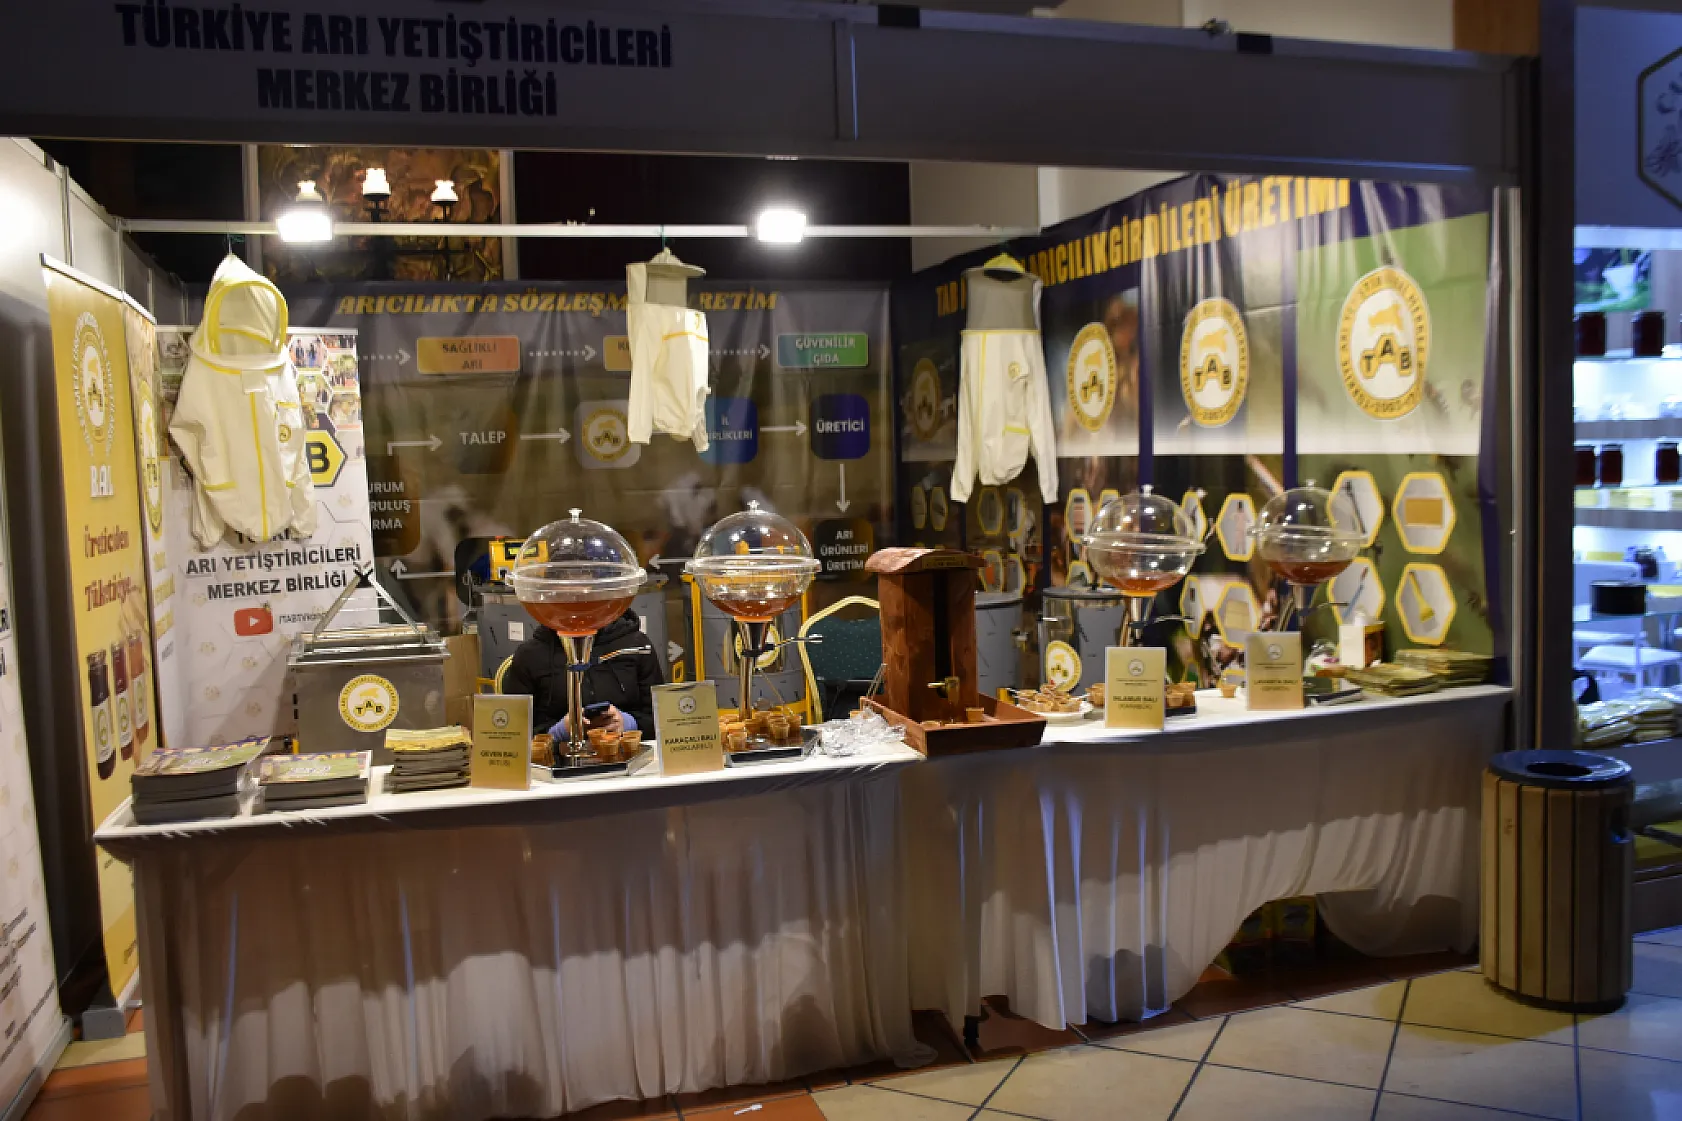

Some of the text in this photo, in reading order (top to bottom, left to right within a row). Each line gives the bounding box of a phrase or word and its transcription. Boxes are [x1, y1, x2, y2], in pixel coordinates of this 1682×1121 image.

[115, 0, 673, 68] TÜRKİYE ARI YETİŞTİRİCİLERİ
[257, 67, 557, 116] MERKEZ BİRLİĞİ
[335, 294, 498, 315] ARICILIKTA
[795, 336, 856, 350] GÜVENİLİR
[1363, 339, 1410, 372] TAB
[1195, 359, 1230, 387] TAB
[816, 416, 865, 433] ÜRETİCİ
[459, 430, 507, 446] TALEP
[835, 529, 854, 540] ARI
[186, 558, 217, 574] ARI
[221, 543, 361, 572] YETİŞTİRİCİLERİ
[820, 543, 868, 556] ÜRÜNLERİ
[207, 569, 347, 600] MERKEZ BİRLİĞİ
[356, 700, 384, 714] TAB
